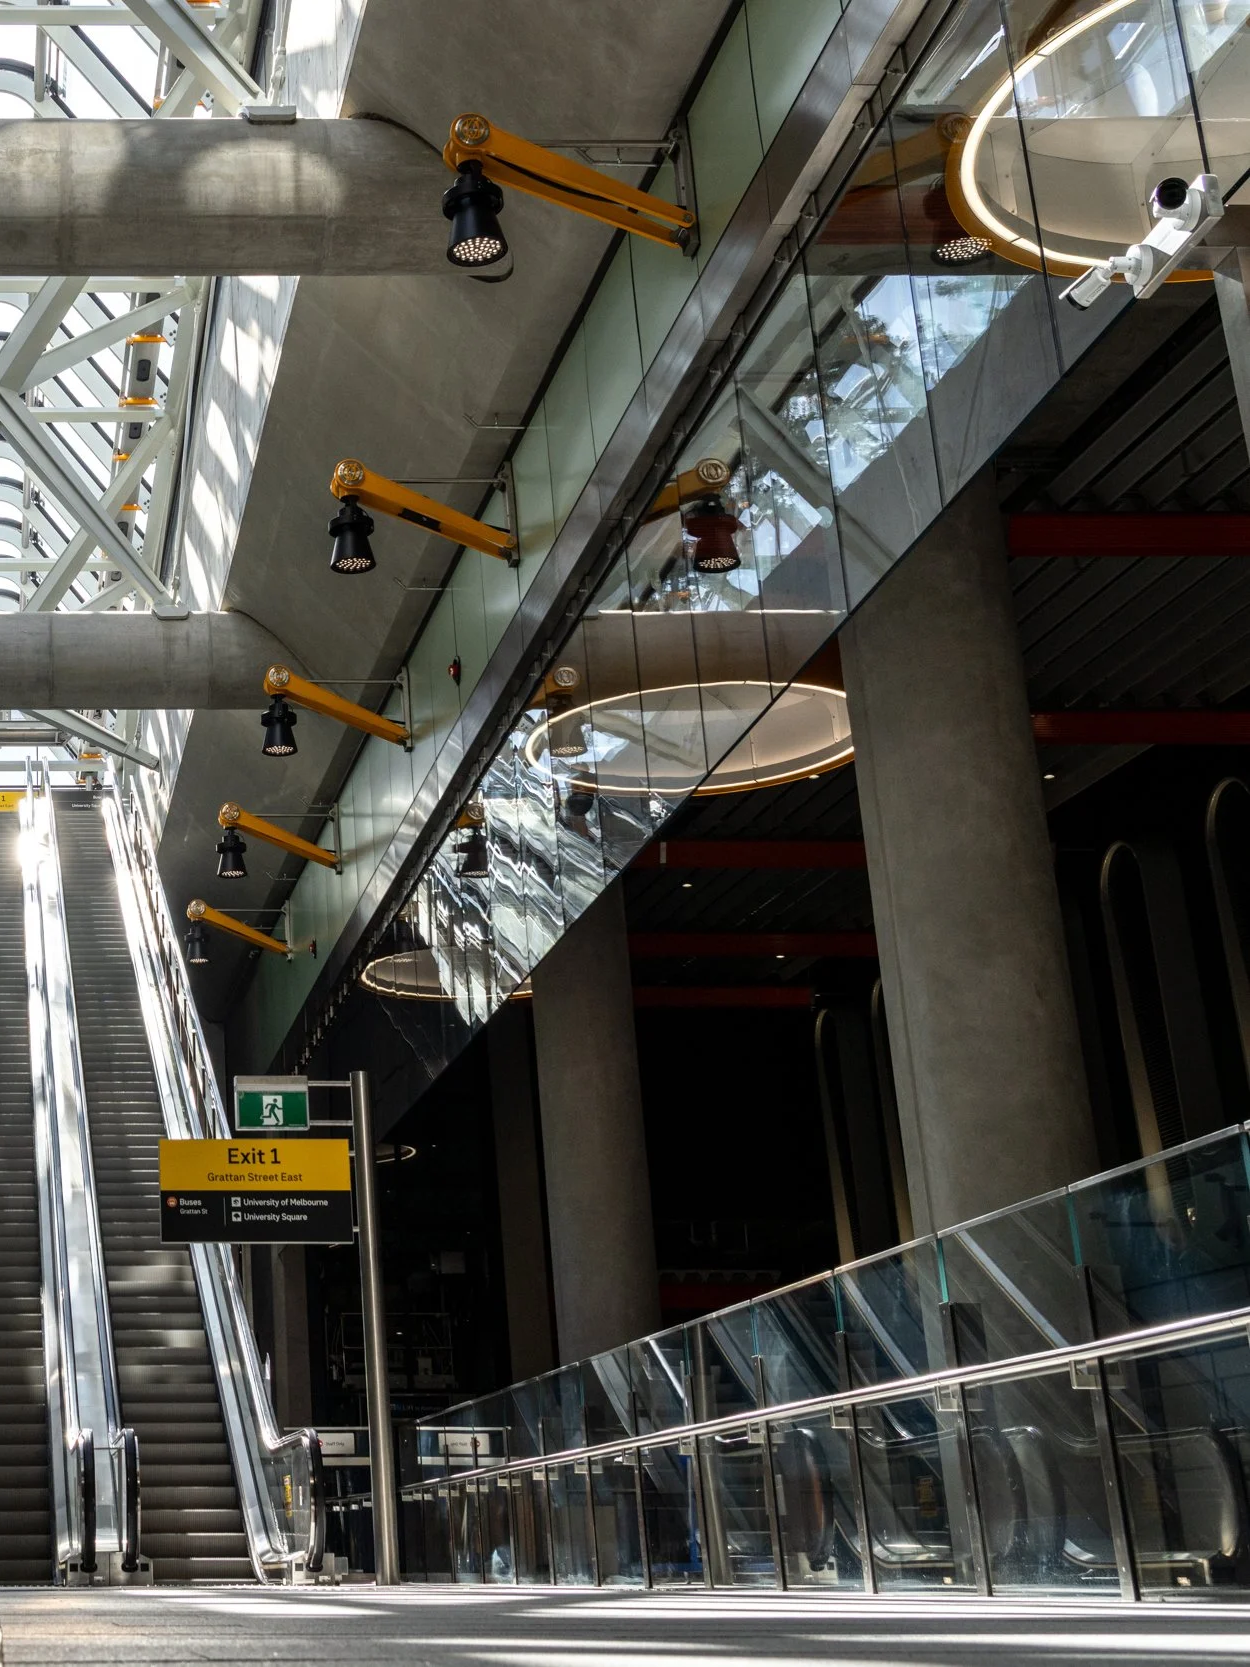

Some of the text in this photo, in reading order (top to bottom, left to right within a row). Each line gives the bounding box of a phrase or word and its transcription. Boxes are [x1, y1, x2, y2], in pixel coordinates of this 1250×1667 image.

[227, 1147, 281, 1165] Exit 1
[207, 1172, 303, 1182] Grattan Street East
[179, 1198, 202, 1206] Buses
[243, 1198, 329, 1208] University of Melbourne
[244, 1213, 308, 1222] University Square
